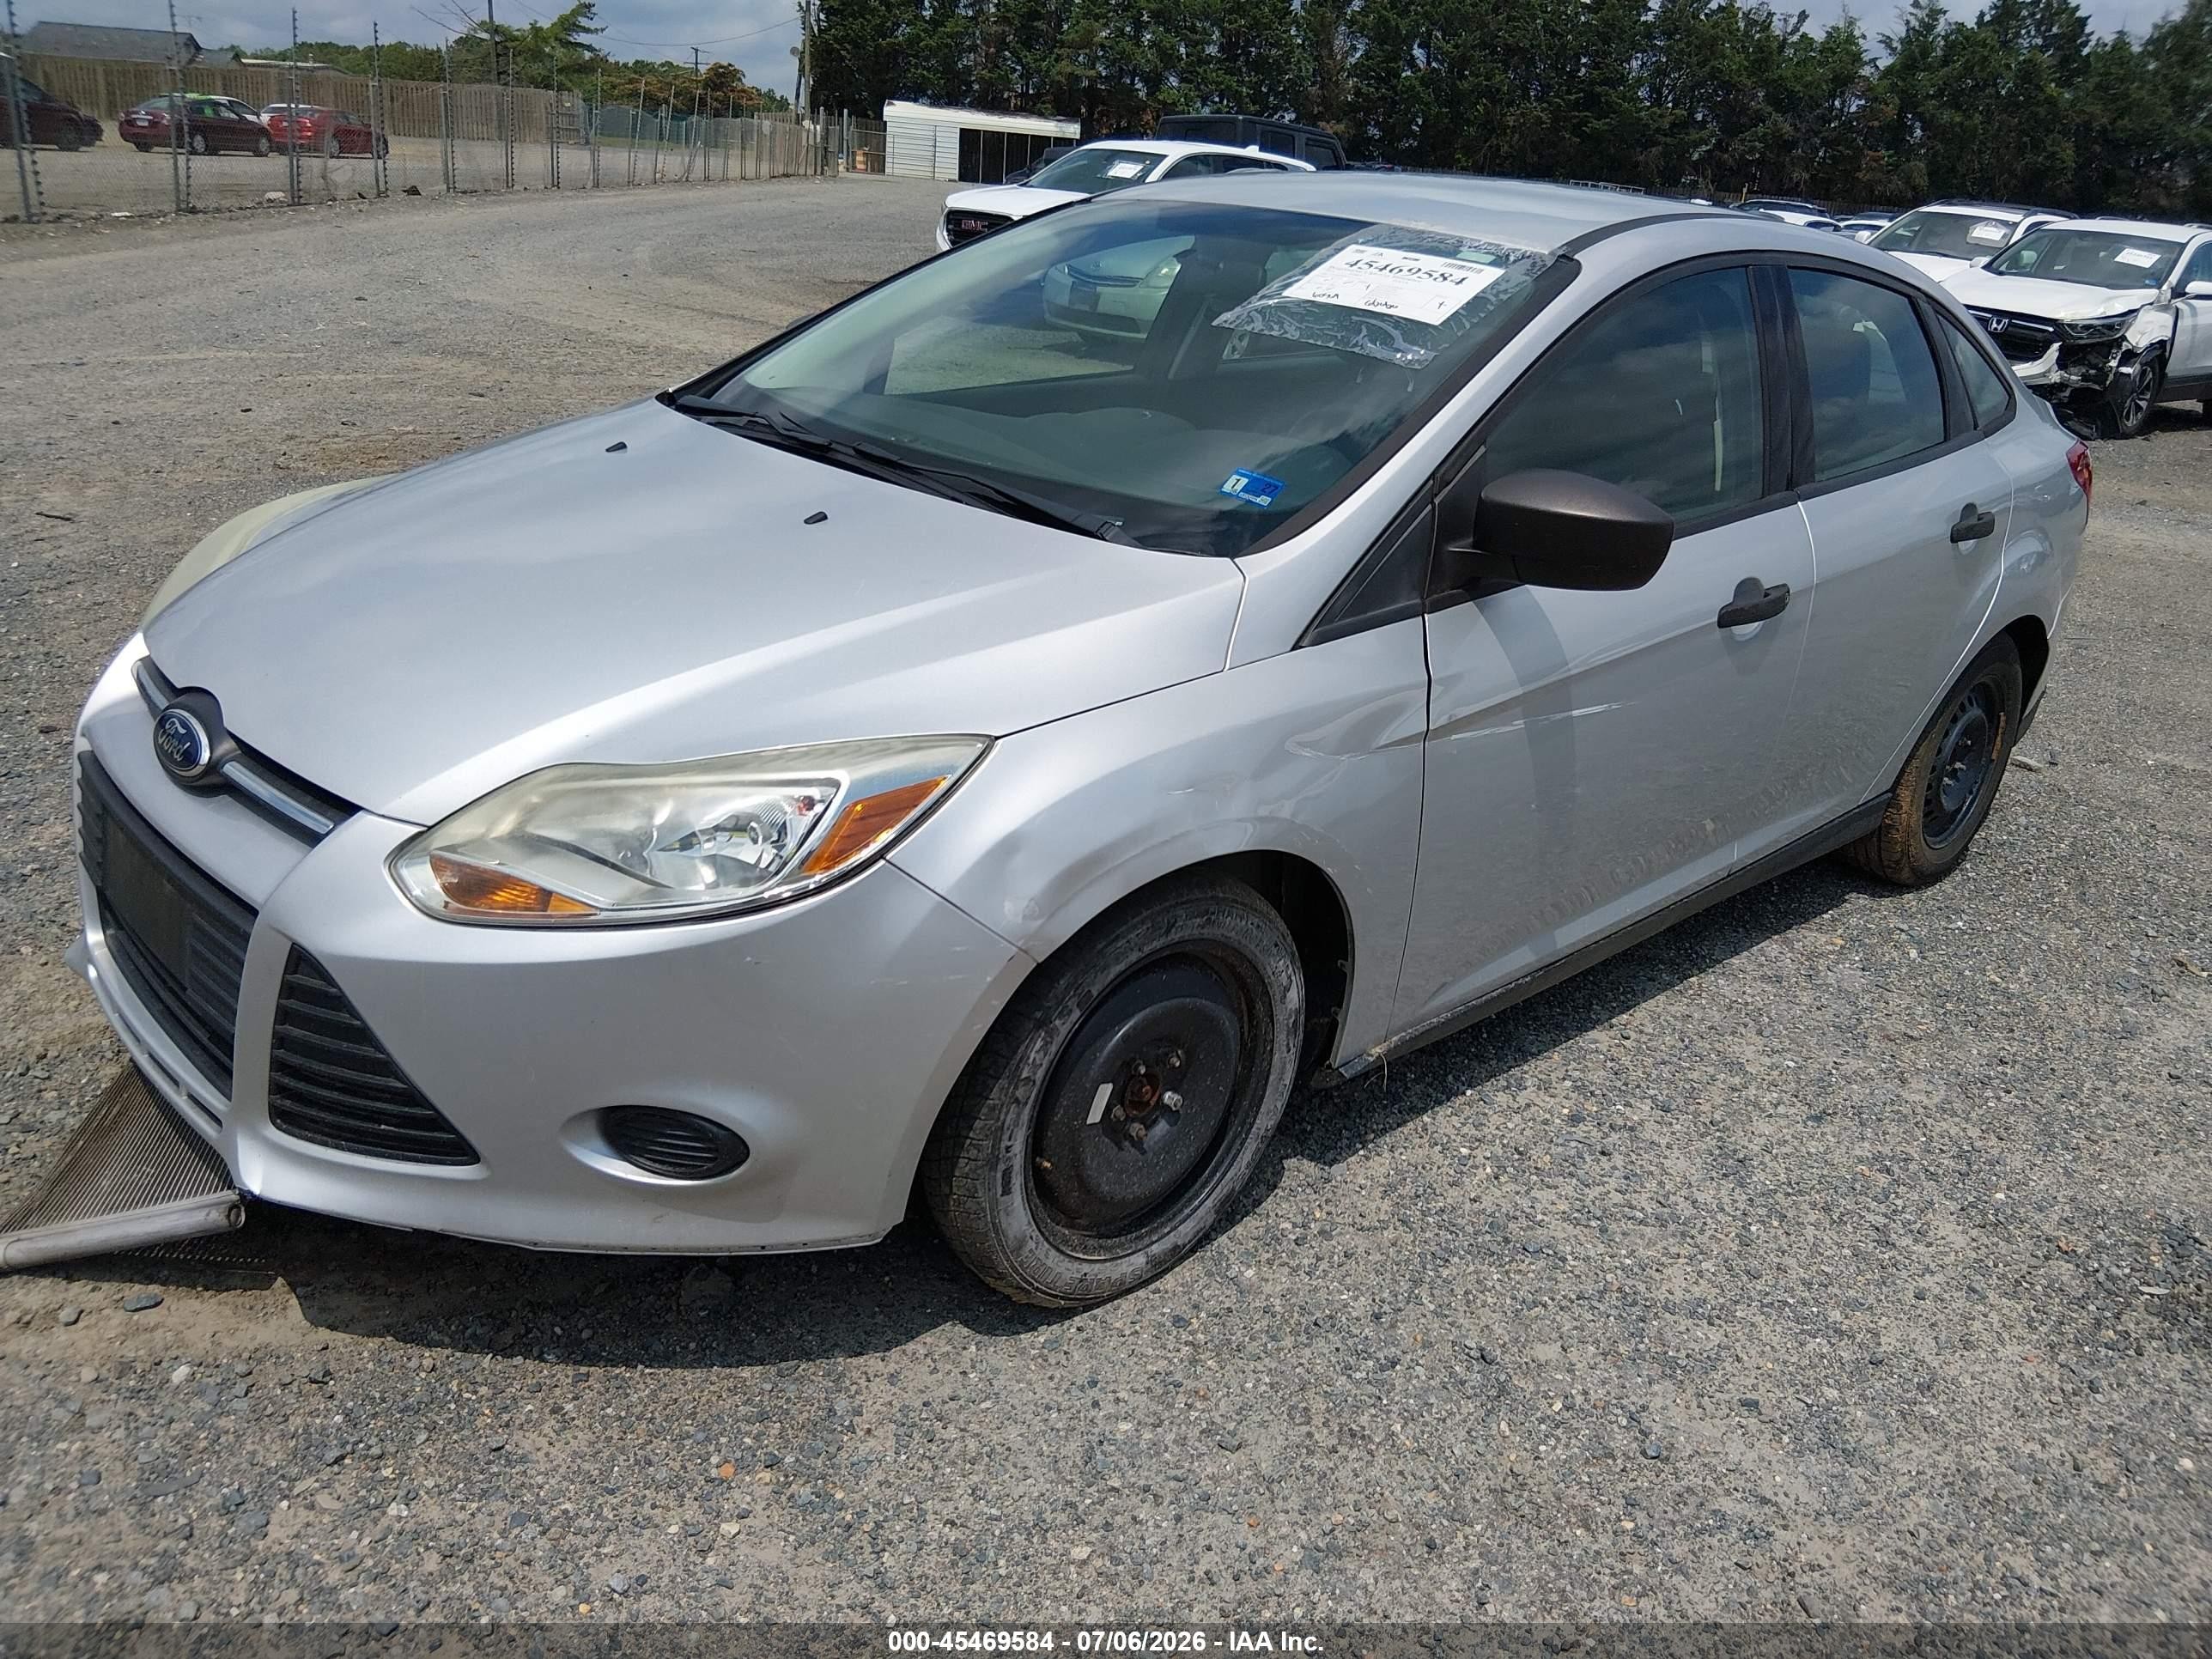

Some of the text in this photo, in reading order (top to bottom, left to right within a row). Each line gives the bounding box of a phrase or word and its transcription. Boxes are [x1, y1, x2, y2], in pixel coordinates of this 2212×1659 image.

[961, 220, 988, 233] GMC
[1344, 258, 1469, 286] 45469584
[158, 718, 191, 762] Ford
